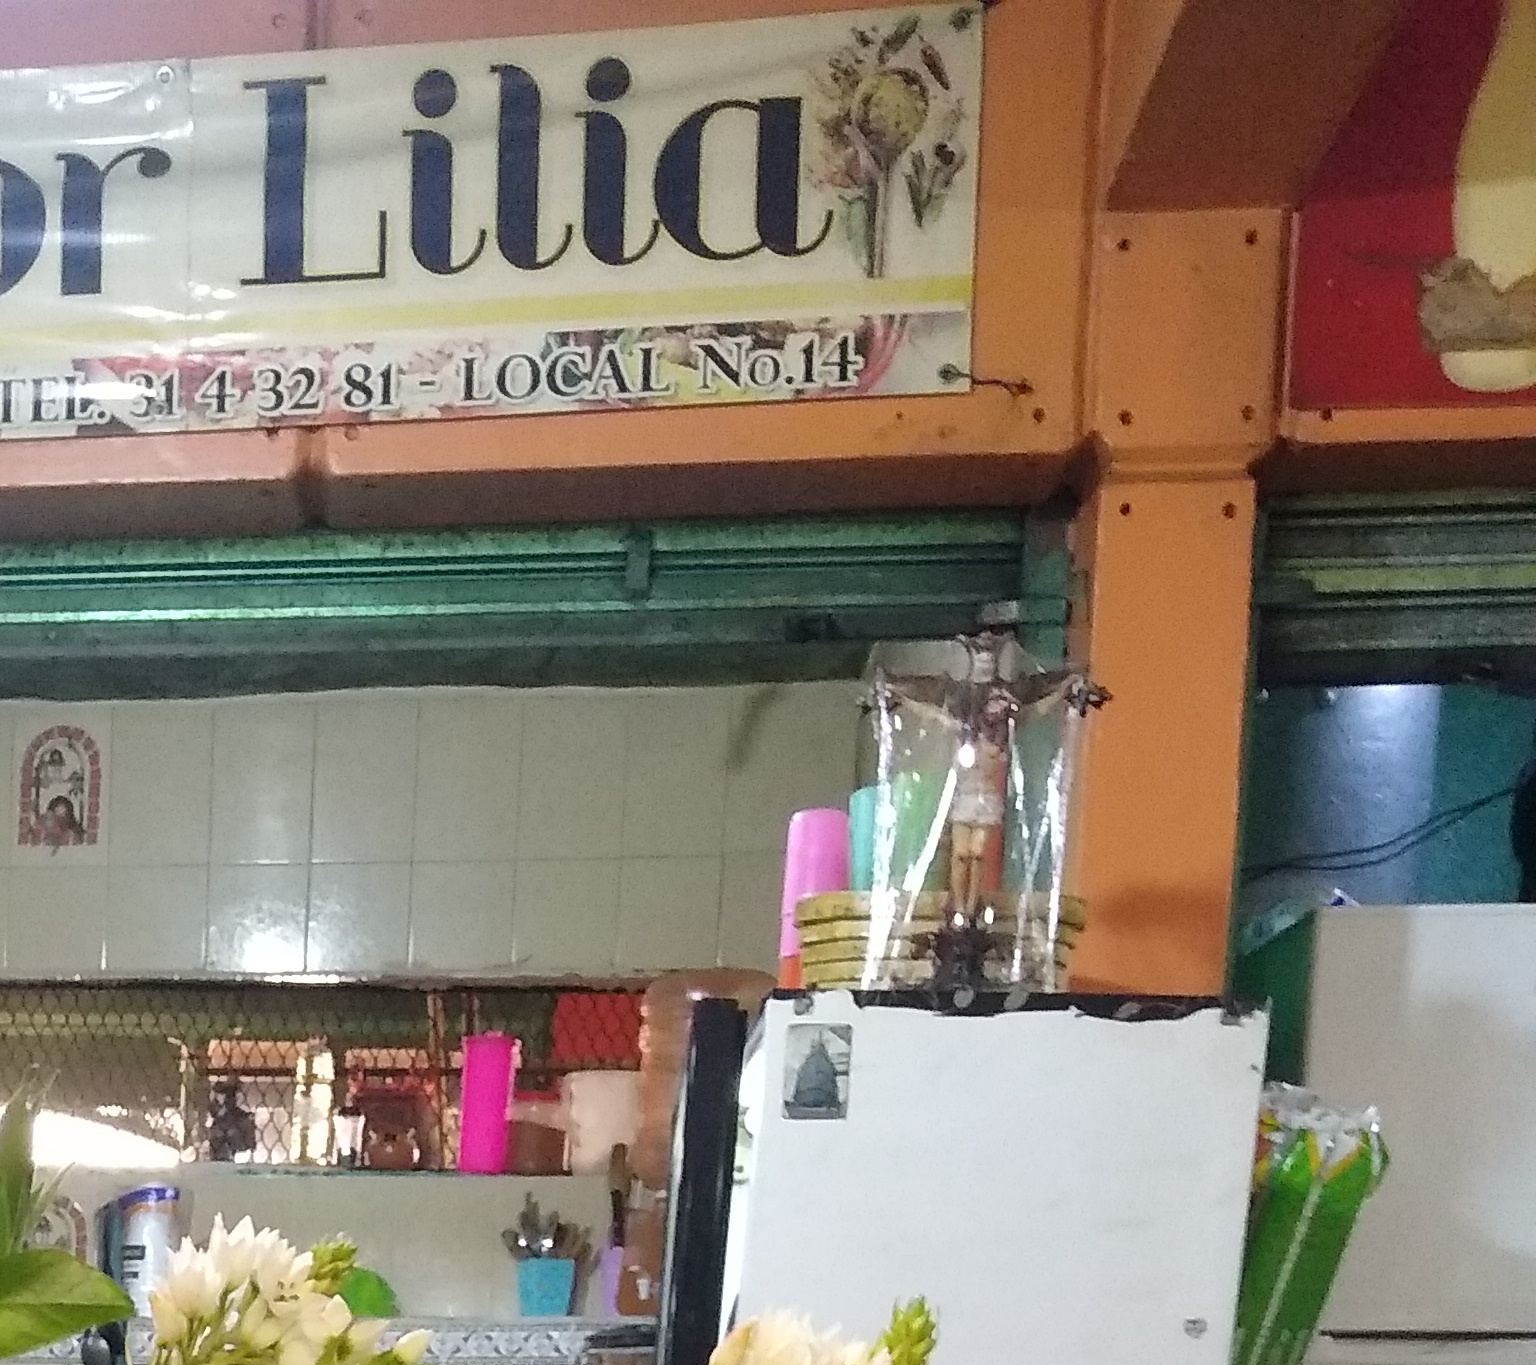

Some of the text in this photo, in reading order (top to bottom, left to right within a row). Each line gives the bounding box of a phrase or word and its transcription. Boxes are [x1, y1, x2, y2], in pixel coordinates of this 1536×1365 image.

[239, 56, 833, 290] Lilia
[197, 369, 236, 414] 4
[257, 365, 320, 412] 32
[344, 361, 398, 408] 81
[461, 346, 671, 401] LOCAL
[696, 334, 863, 391] No.14
